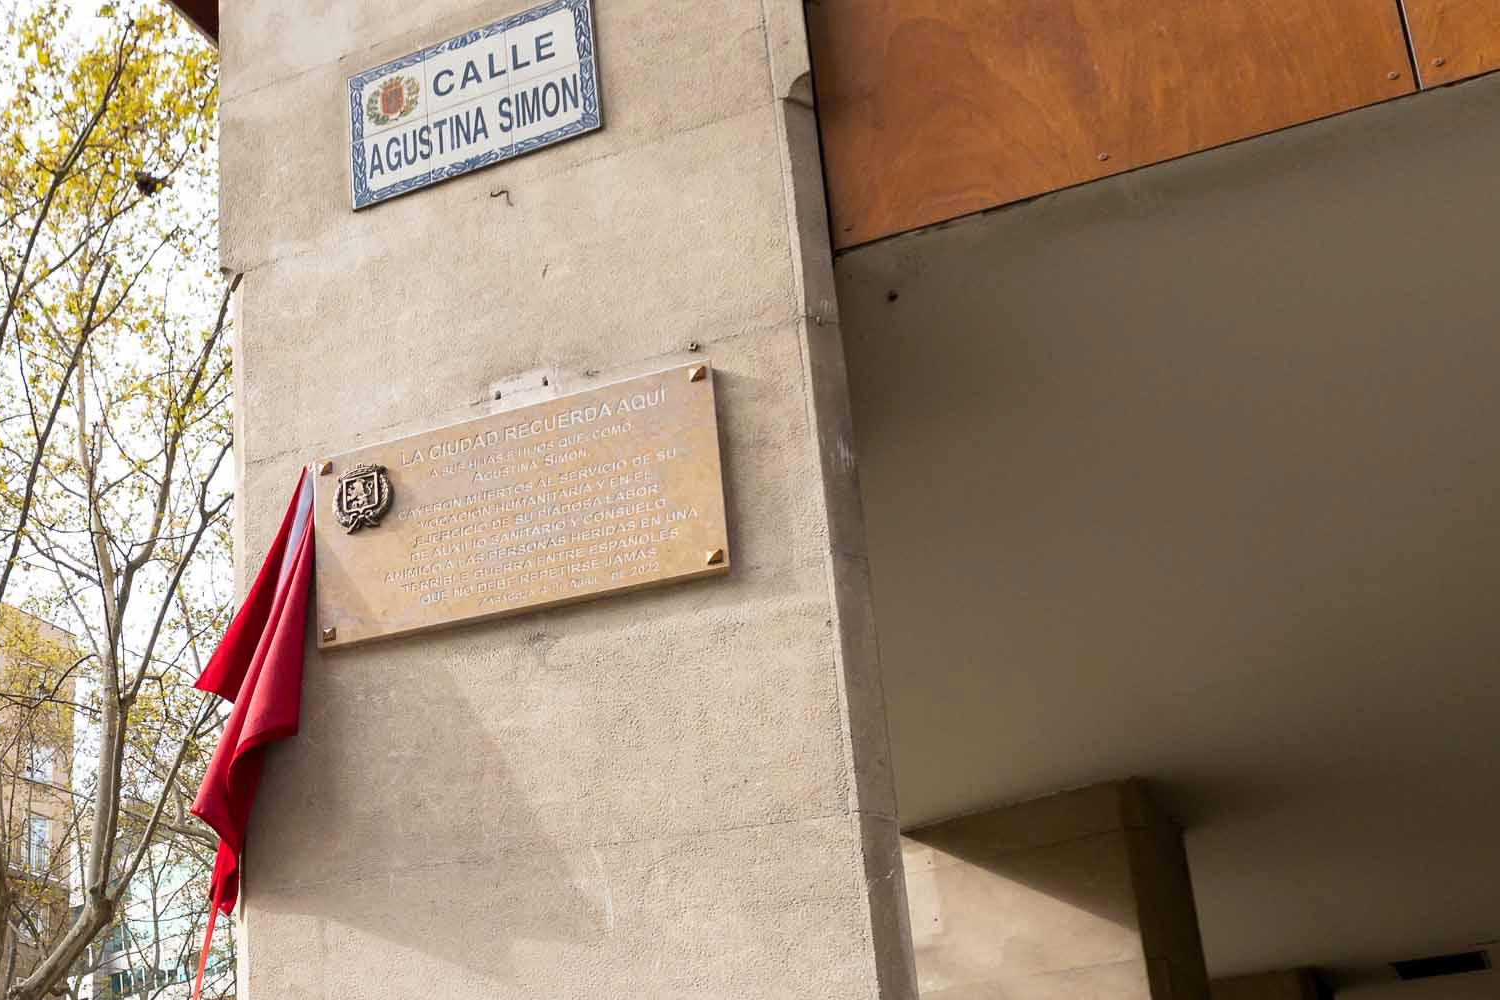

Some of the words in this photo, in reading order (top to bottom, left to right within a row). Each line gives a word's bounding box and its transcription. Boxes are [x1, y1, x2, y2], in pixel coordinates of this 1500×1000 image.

[432, 31, 556, 97] CALLE
[368, 106, 489, 180] AGUSTINA
[498, 73, 581, 133] SIMON
[401, 447, 423, 467] LA
[430, 429, 497, 460] CIUDAD
[505, 400, 611, 441] RECUERDA
[398, 497, 460, 520] CAYERON
[466, 480, 532, 505] MUERTOS
[537, 475, 554, 488] AL
[559, 459, 626, 483] SERVICIO
[632, 453, 651, 466] DE
[656, 447, 676, 461] SU
[414, 522, 486, 546] EJERCICIO
[492, 517, 508, 529] DE
[515, 512, 531, 524] SU
[538, 496, 601, 519] PIADOSA
[606, 484, 657, 504] LABOR
[496, 482, 591, 513] HUMANITARIA
[597, 479, 603, 490] Y
[610, 474, 627, 487] EN
[634, 468, 651, 481] EL
[411, 549, 428, 562] DE
[433, 537, 486, 557] AUXILIO
[490, 519, 564, 545] SANITARIO
[569, 517, 576, 527] Y
[583, 497, 665, 524] CONSUELO
[444, 559, 453, 570] A
[459, 552, 483, 567] LAS
[488, 534, 565, 560] PERSONAS
[571, 520, 634, 542] HERIDAS
[640, 514, 659, 528] EN
[666, 506, 697, 522] UNA
[401, 571, 467, 594] TERRIBLE
[474, 557, 531, 579] GUERRA
[537, 546, 583, 565] ENTRE
[421, 590, 448, 604] QUE
[454, 585, 472, 598] NO
[478, 576, 515, 593] DEBE
[520, 558, 599, 584] REPETIRSE
